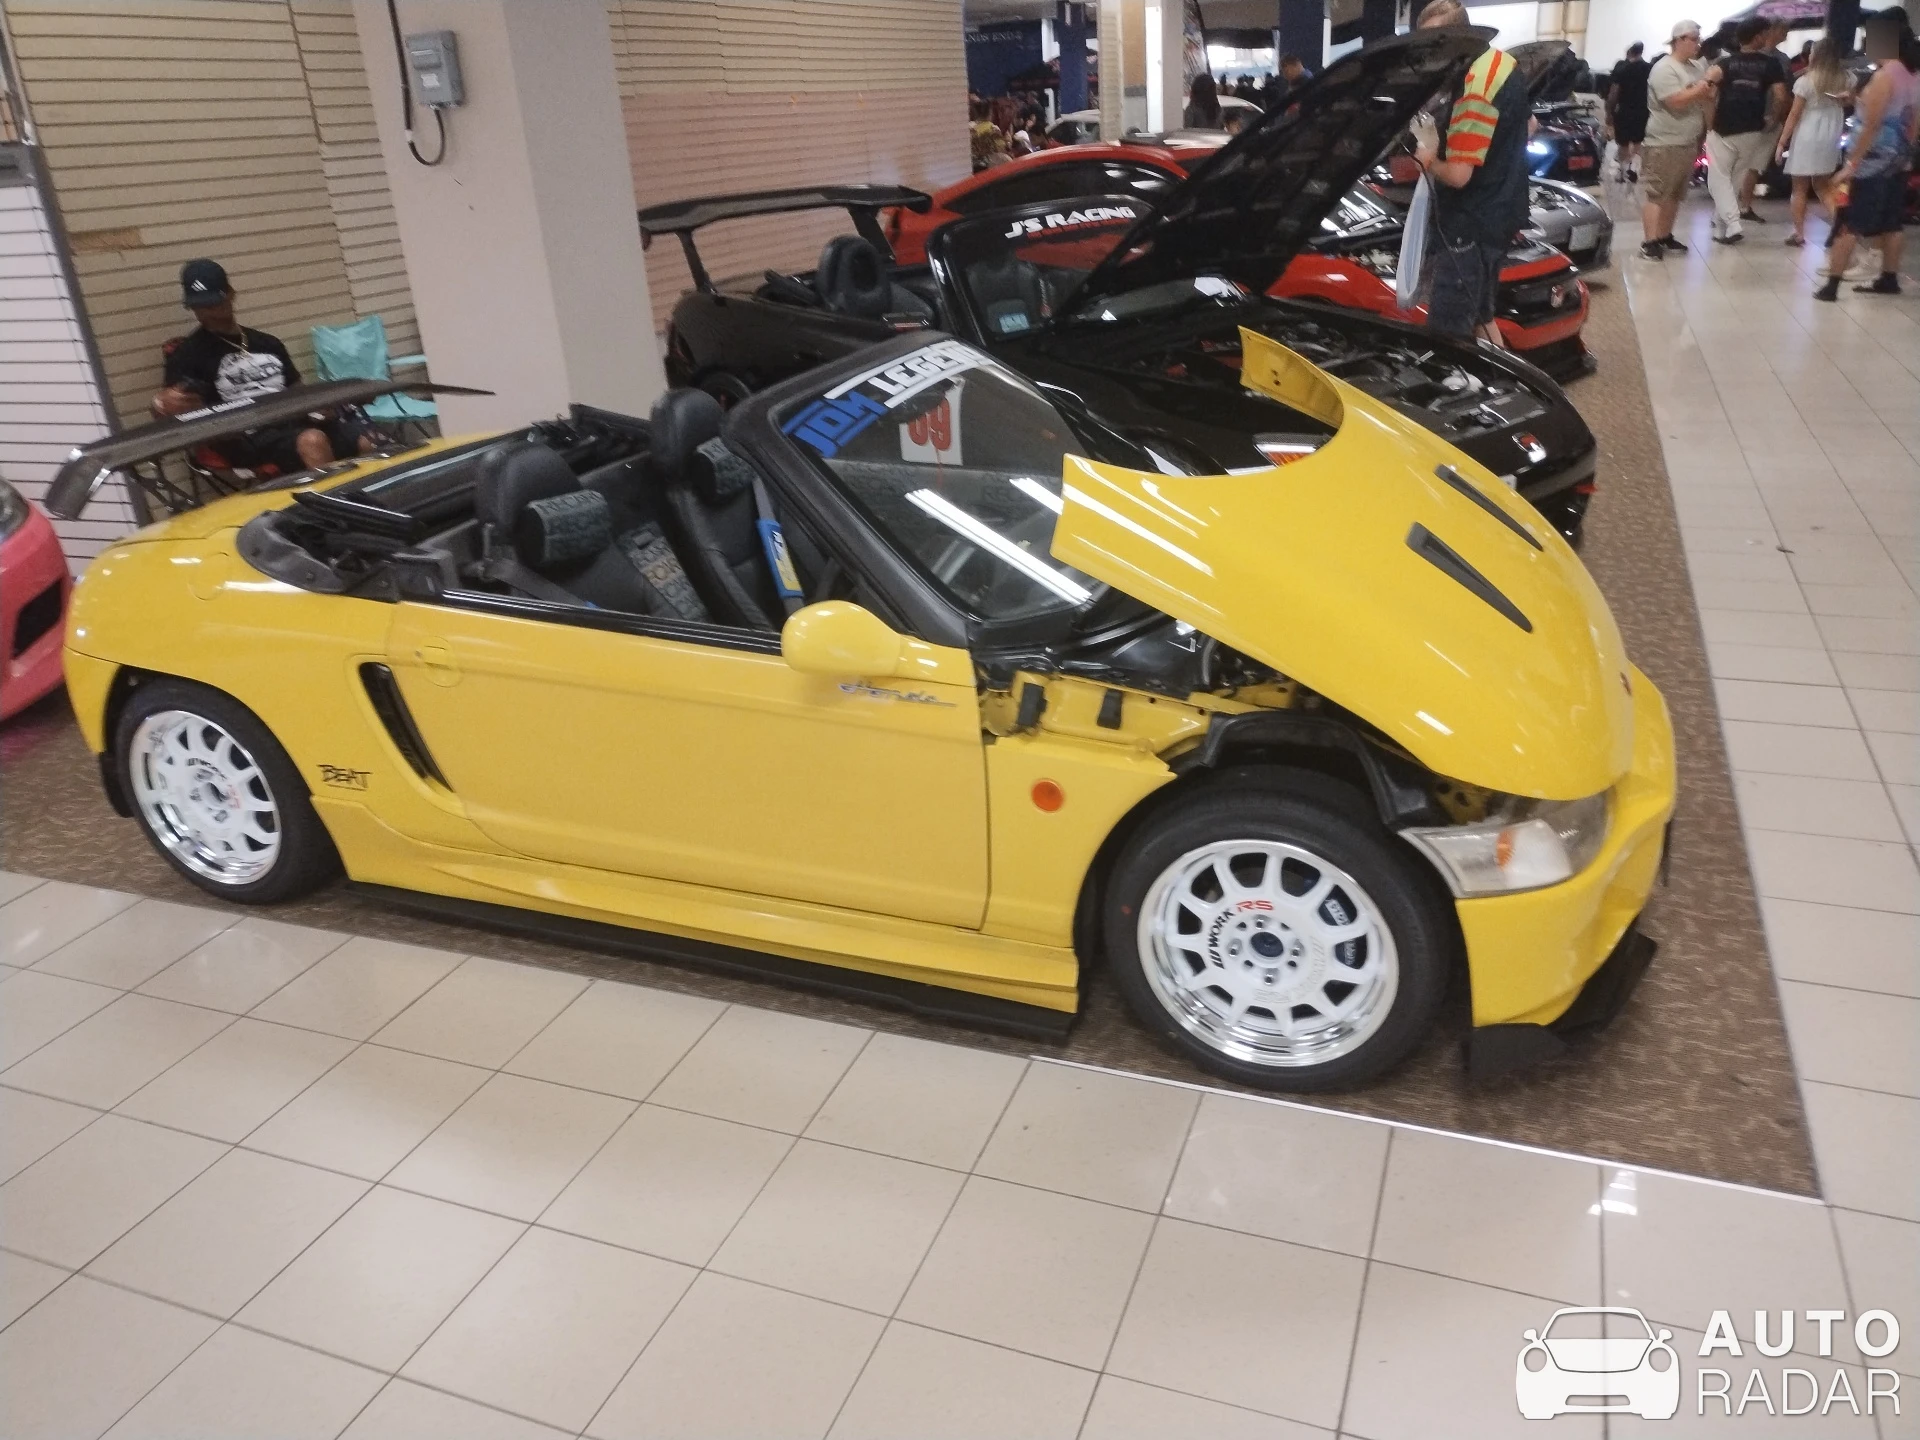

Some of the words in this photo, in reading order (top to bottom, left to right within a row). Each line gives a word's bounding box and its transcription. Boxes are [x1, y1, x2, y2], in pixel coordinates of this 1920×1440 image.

[1004, 217, 1043, 238] J'S
[1045, 206, 1136, 228] RACING
[793, 390, 889, 458] JDM
[317, 764, 373, 790] BEAT
[1208, 908, 1235, 948] WORK
[1235, 900, 1274, 912] RS
